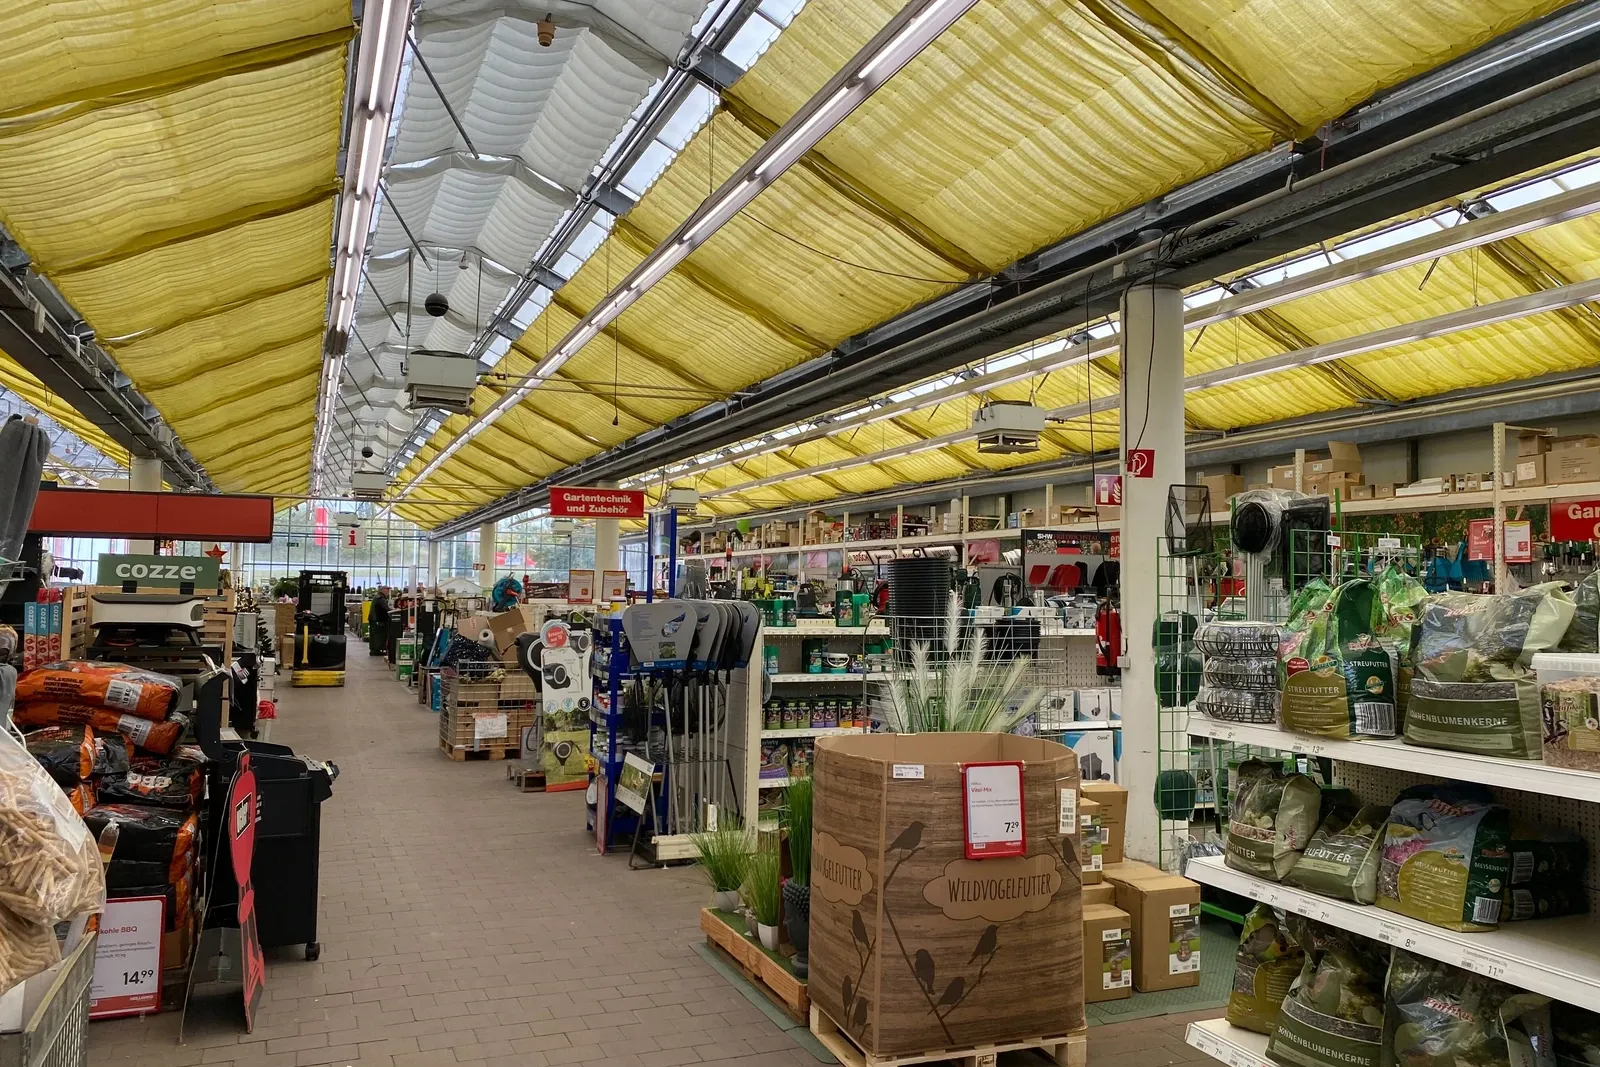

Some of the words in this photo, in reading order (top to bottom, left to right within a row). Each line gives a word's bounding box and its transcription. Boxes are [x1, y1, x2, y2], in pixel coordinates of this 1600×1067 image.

[563, 493, 631, 503] Gartentechnik
[566, 505, 585, 513] und
[588, 504, 628, 514] Zubehör
[115, 563, 196, 580] cozze
[1349, 660, 1388, 668] STREUFUTTER
[1287, 685, 1340, 694] STREUFUTTER
[1004, 821, 1019, 833] 7.29
[948, 873, 1051, 903] WILDVOGELFUTTER
[123, 969, 154, 985] 14.99
[1277, 1025, 1371, 1066] SONNENBLUMENKERNE
